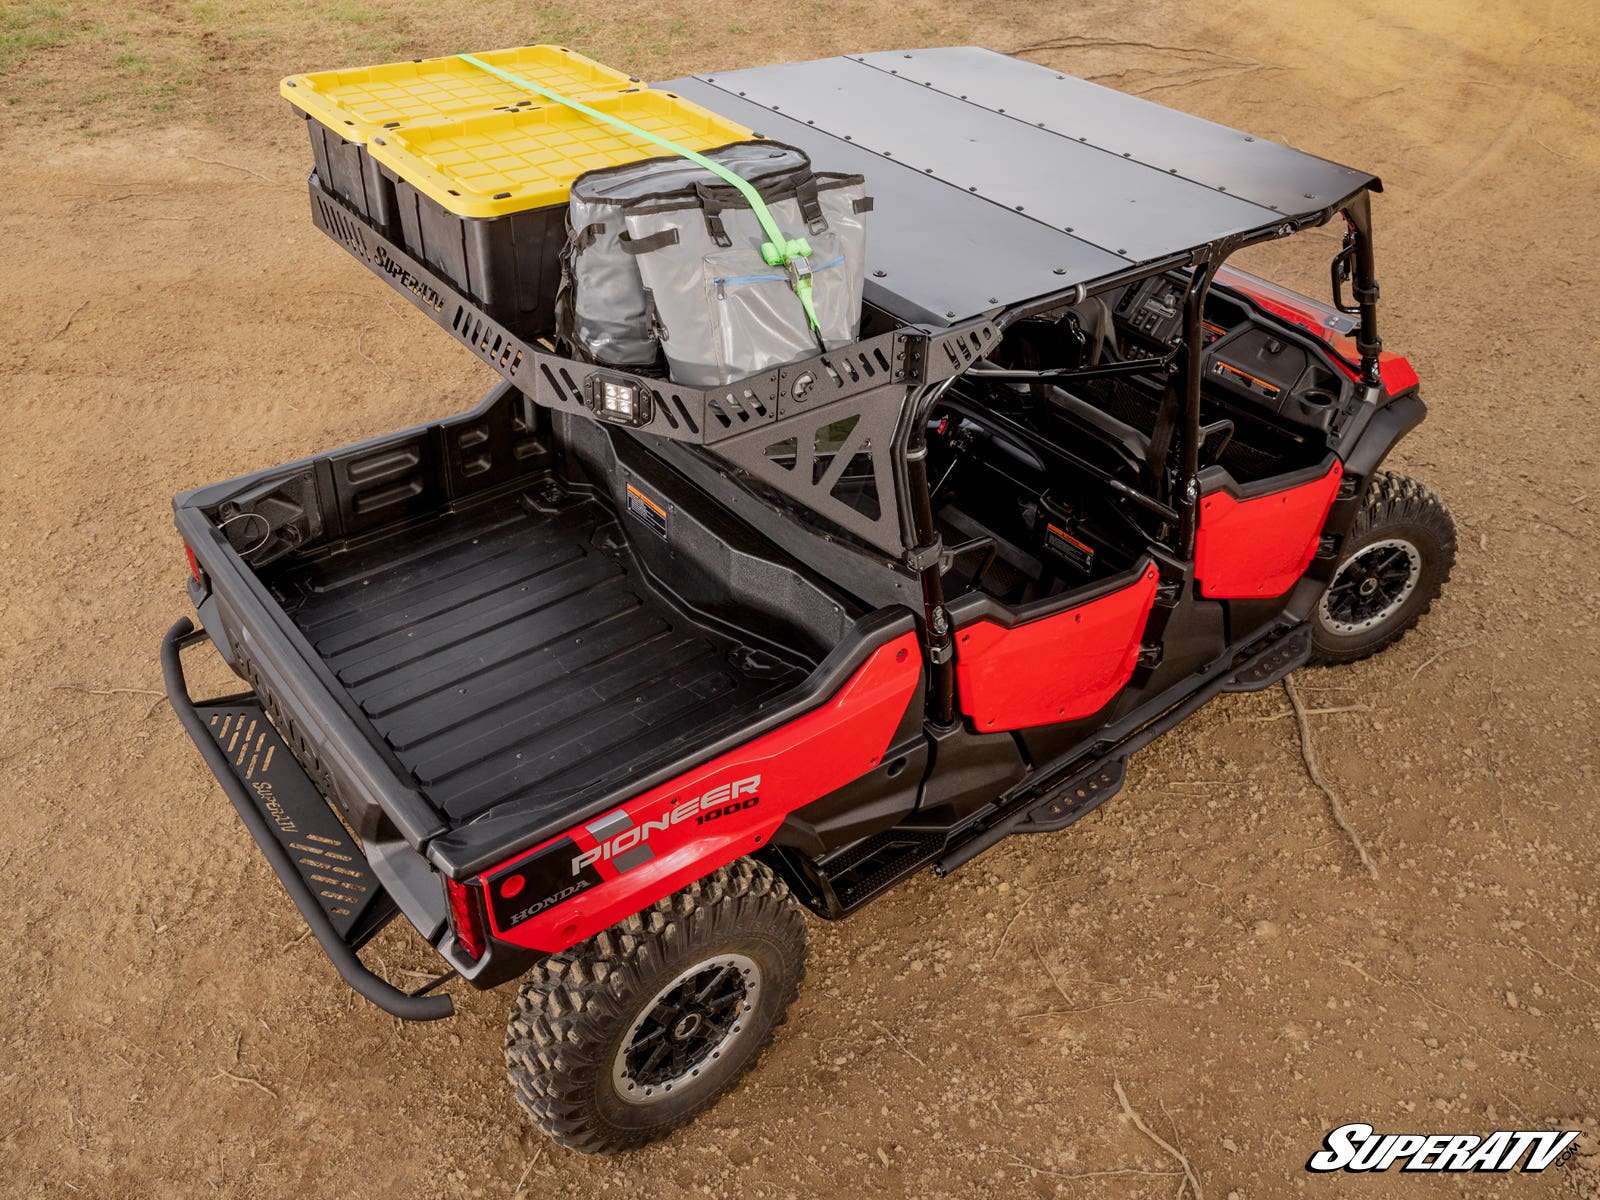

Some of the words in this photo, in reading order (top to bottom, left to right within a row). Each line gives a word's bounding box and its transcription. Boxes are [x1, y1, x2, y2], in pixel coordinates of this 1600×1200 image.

[571, 774, 762, 877] PIONEER
[695, 797, 760, 826] 1000
[509, 878, 593, 926] HONDA
